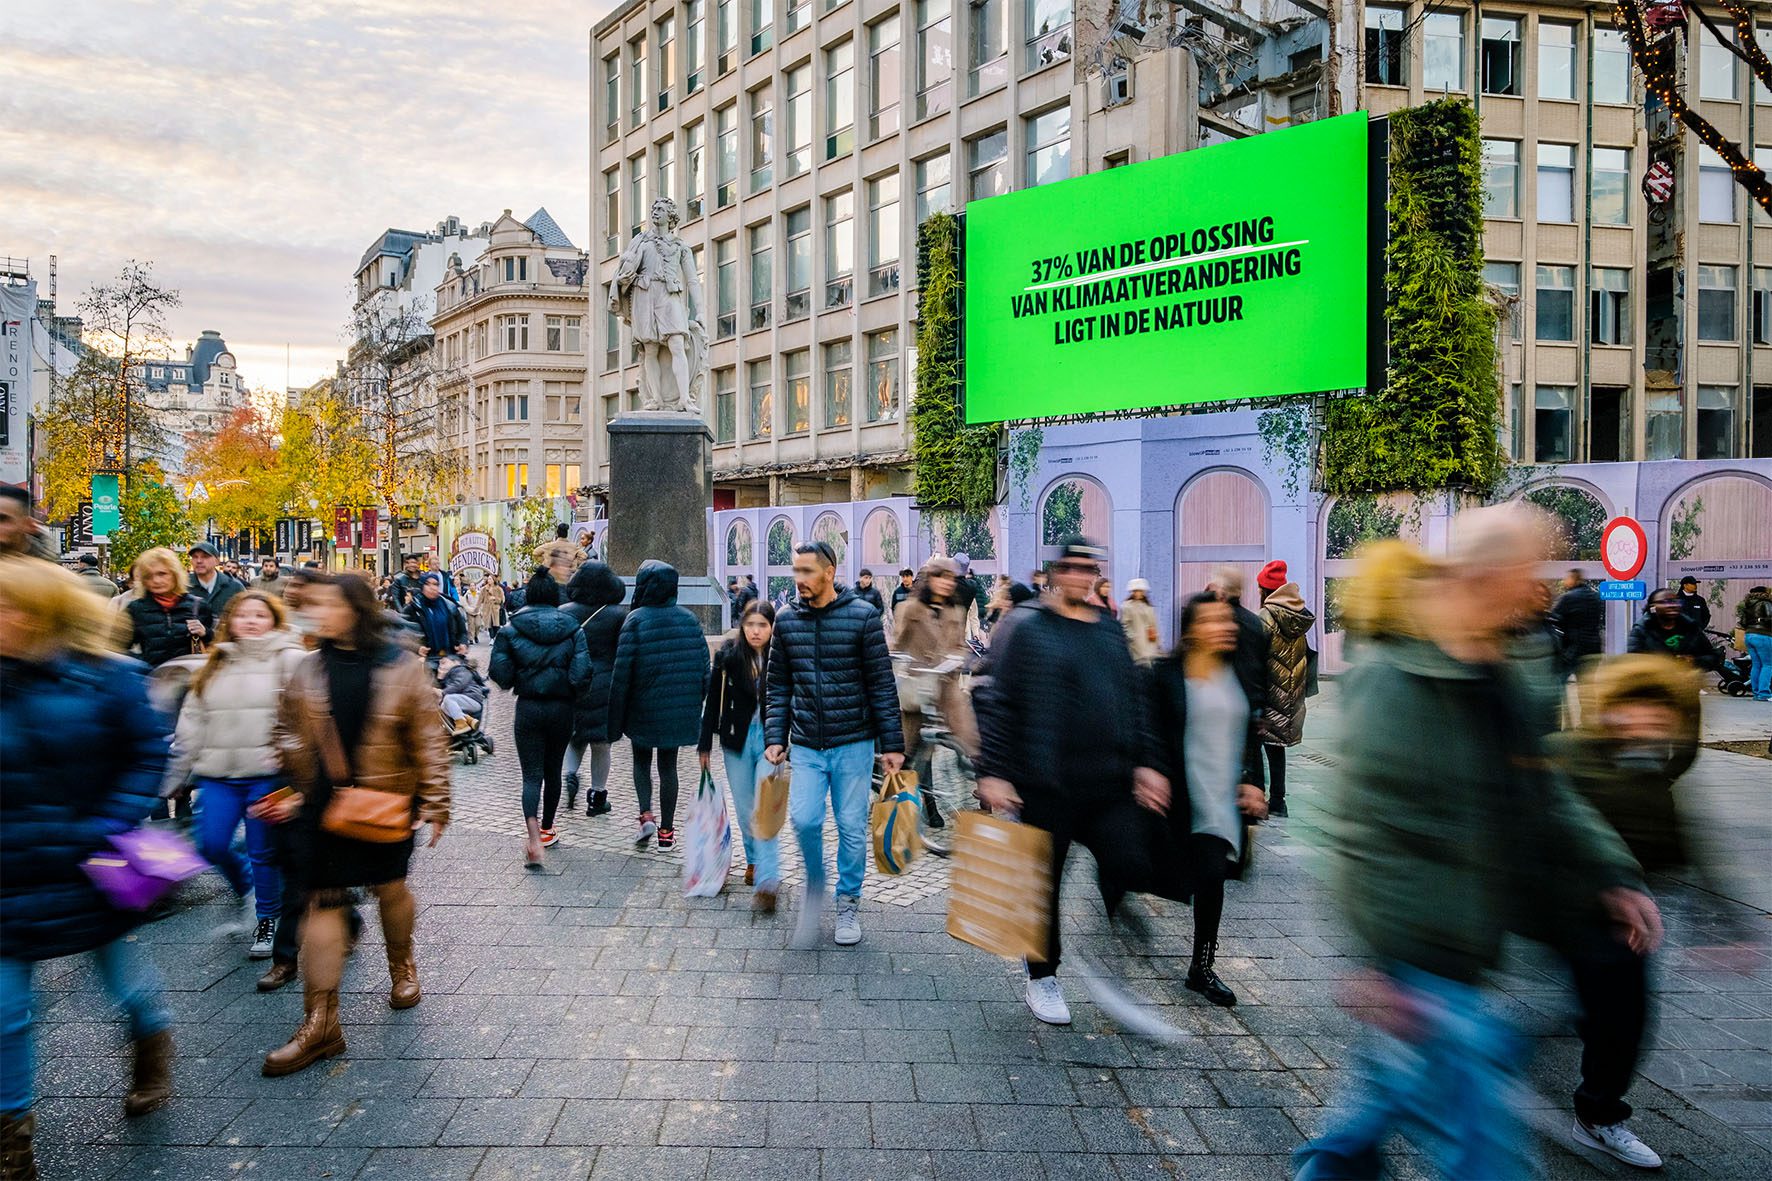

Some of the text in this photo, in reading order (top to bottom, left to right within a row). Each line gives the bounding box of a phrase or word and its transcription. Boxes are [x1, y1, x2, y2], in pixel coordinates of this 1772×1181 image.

[1031, 216, 1275, 283] 37% VAN DE OPLOSSING
[1011, 249, 1301, 319] VAN KLIMAATVERANDERING
[1054, 295, 1244, 345] LIGT IN DE NATUUR
[9, 327, 18, 416] RENOTEC
